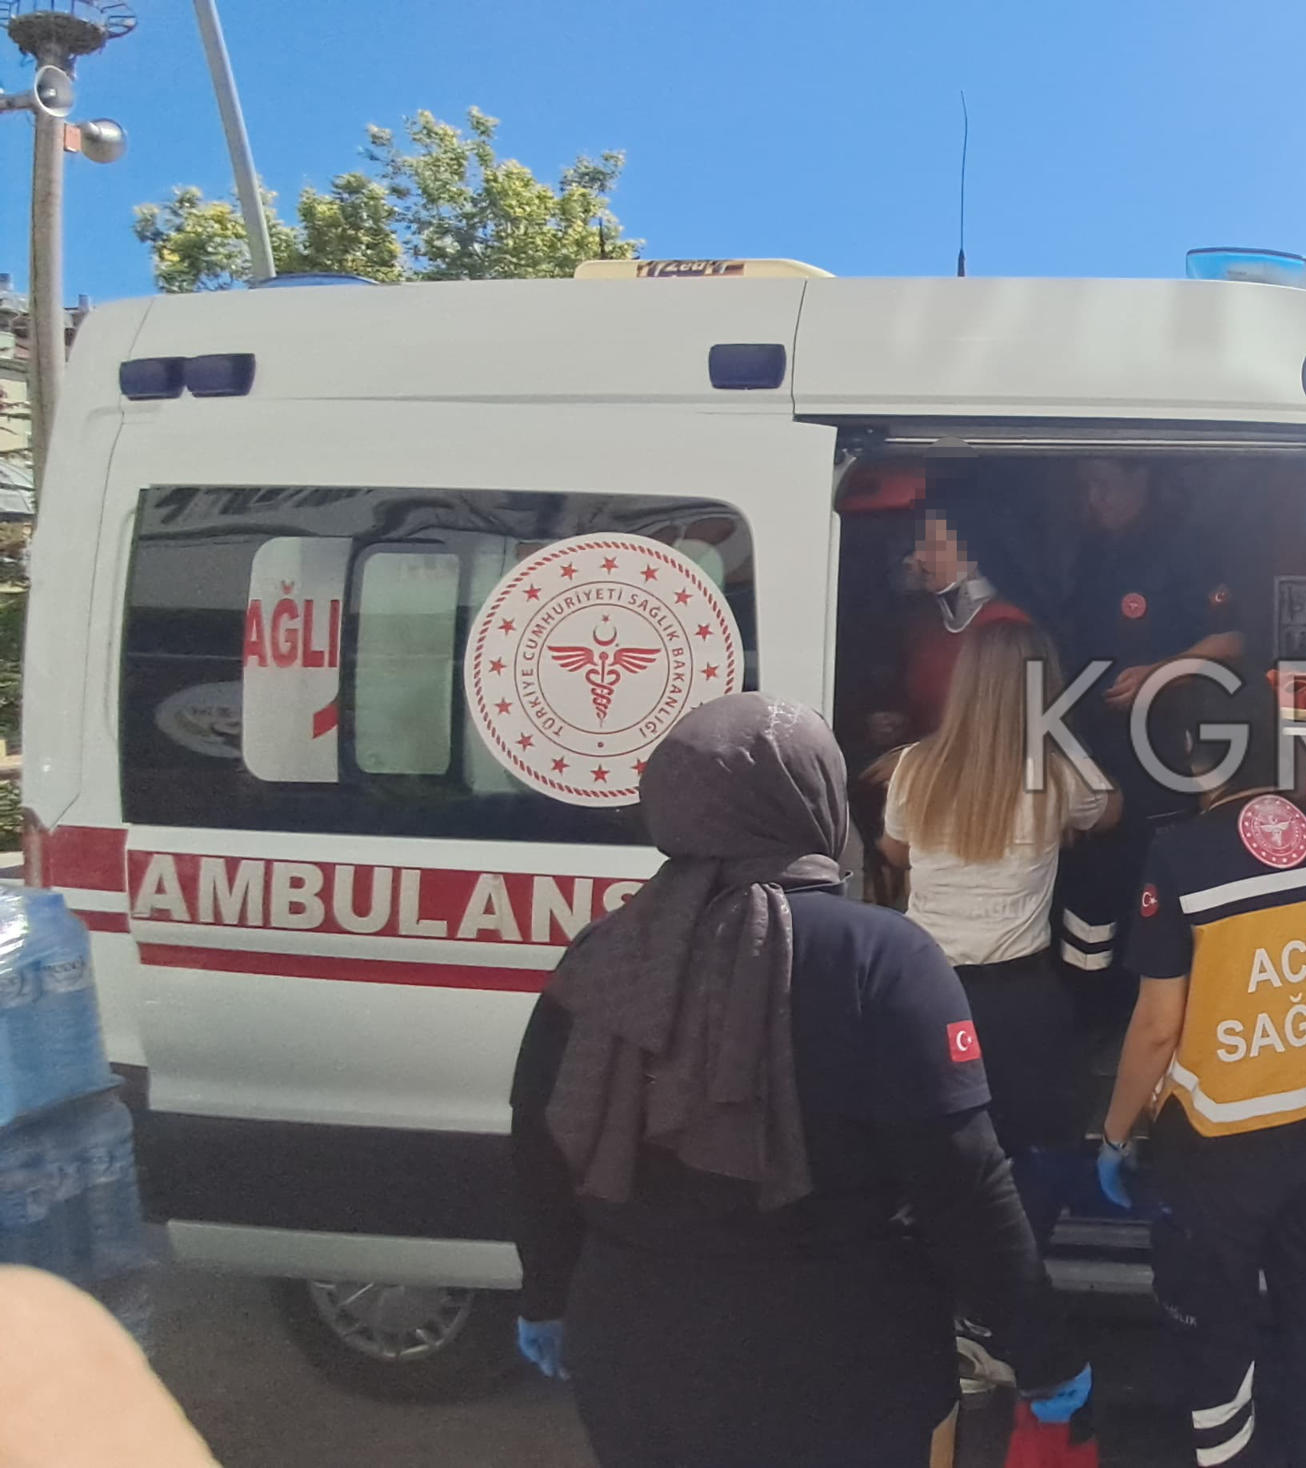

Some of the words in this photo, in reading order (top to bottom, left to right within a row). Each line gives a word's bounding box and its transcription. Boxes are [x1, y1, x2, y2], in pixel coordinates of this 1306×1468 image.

[523, 588, 623, 661] CUMHURİYETİ
[628, 592, 680, 642] SAĞLIK
[521, 667, 564, 737] TÜRKİYE
[638, 646, 686, 738] BAKANLIĞI
